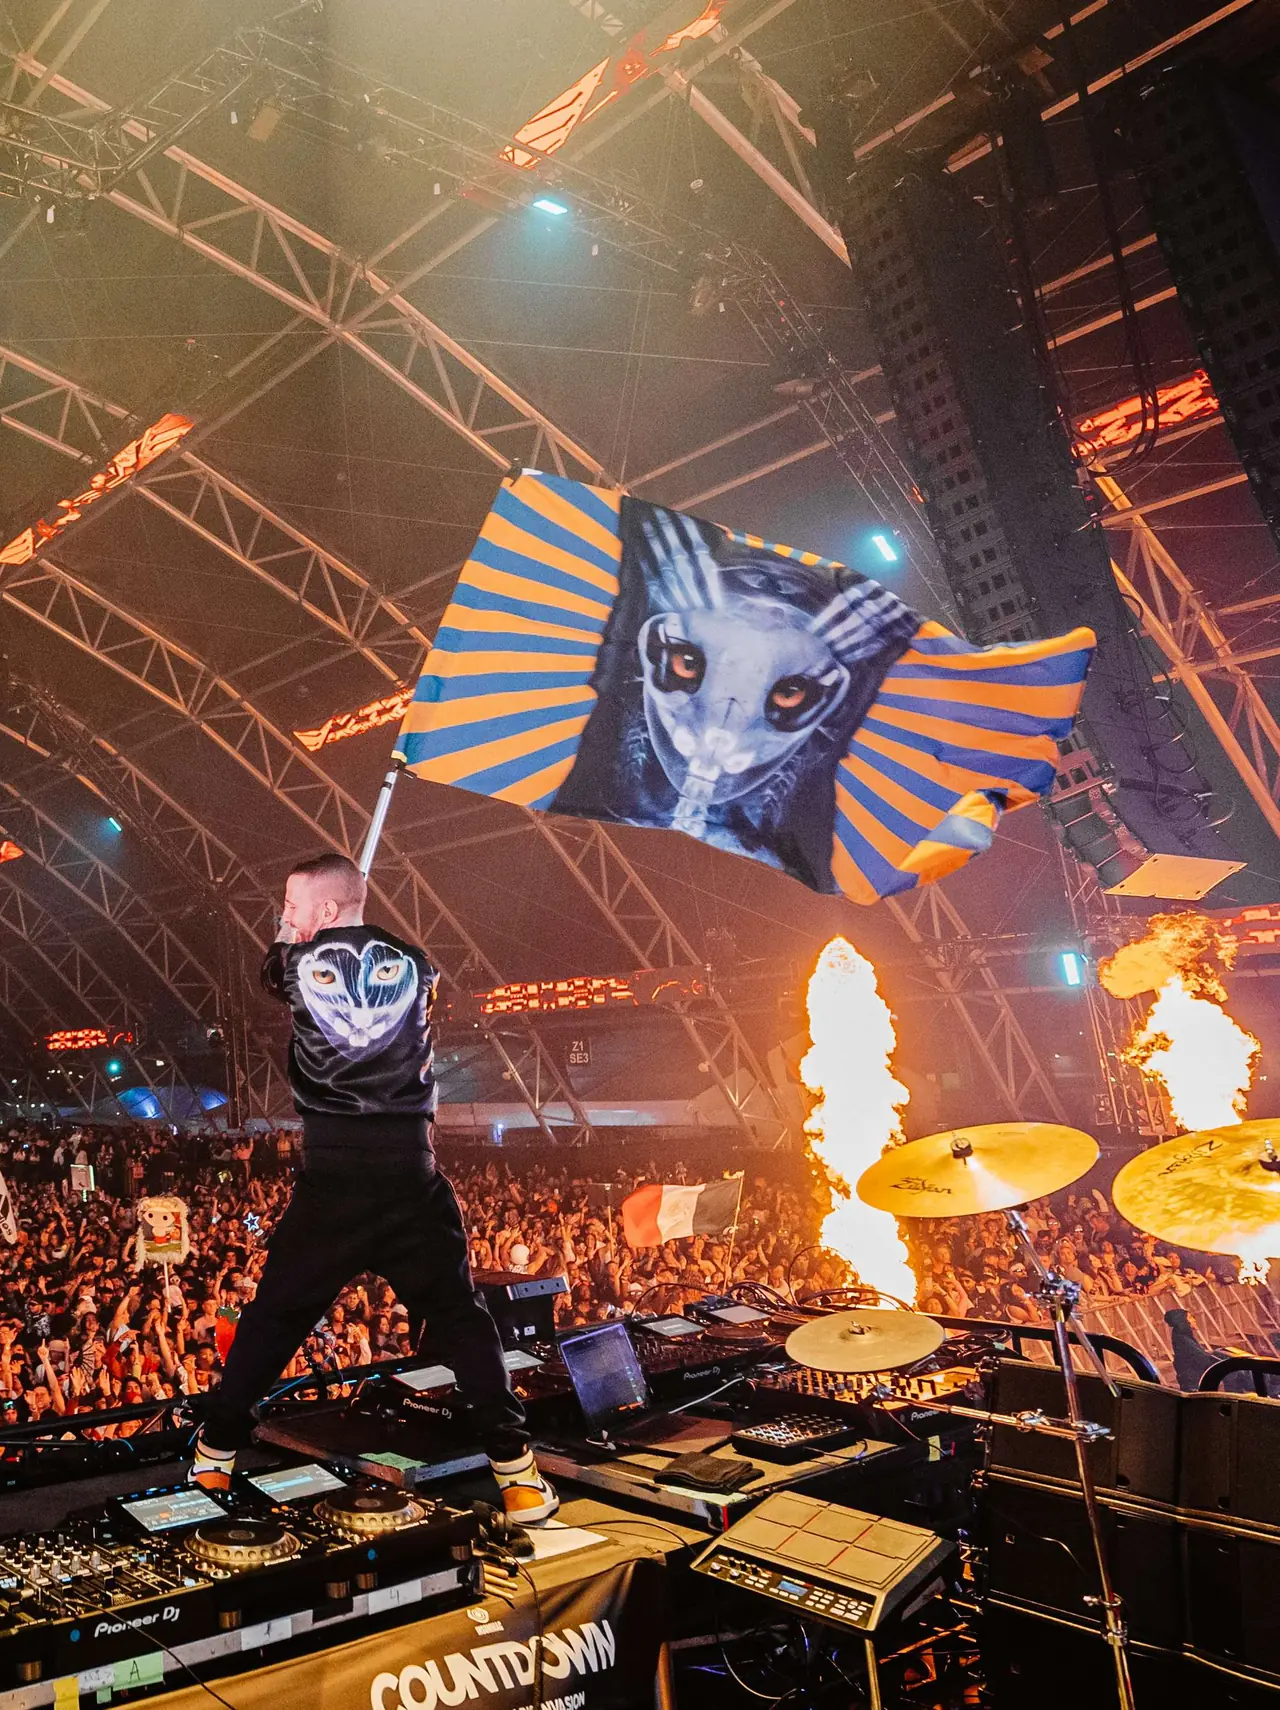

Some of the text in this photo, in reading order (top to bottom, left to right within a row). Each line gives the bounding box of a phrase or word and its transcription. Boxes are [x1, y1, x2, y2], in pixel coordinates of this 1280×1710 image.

[572, 1041, 584, 1051] Z1
[570, 1053, 589, 1064] SE3
[402, 1398, 452, 1419] Pioneer DJ
[94, 1605, 180, 1638] Pioneer DJ
[129, 1660, 141, 1681] A
[370, 1619, 616, 1710] COUNTDOWN
[540, 1690, 585, 1710] NVASION
